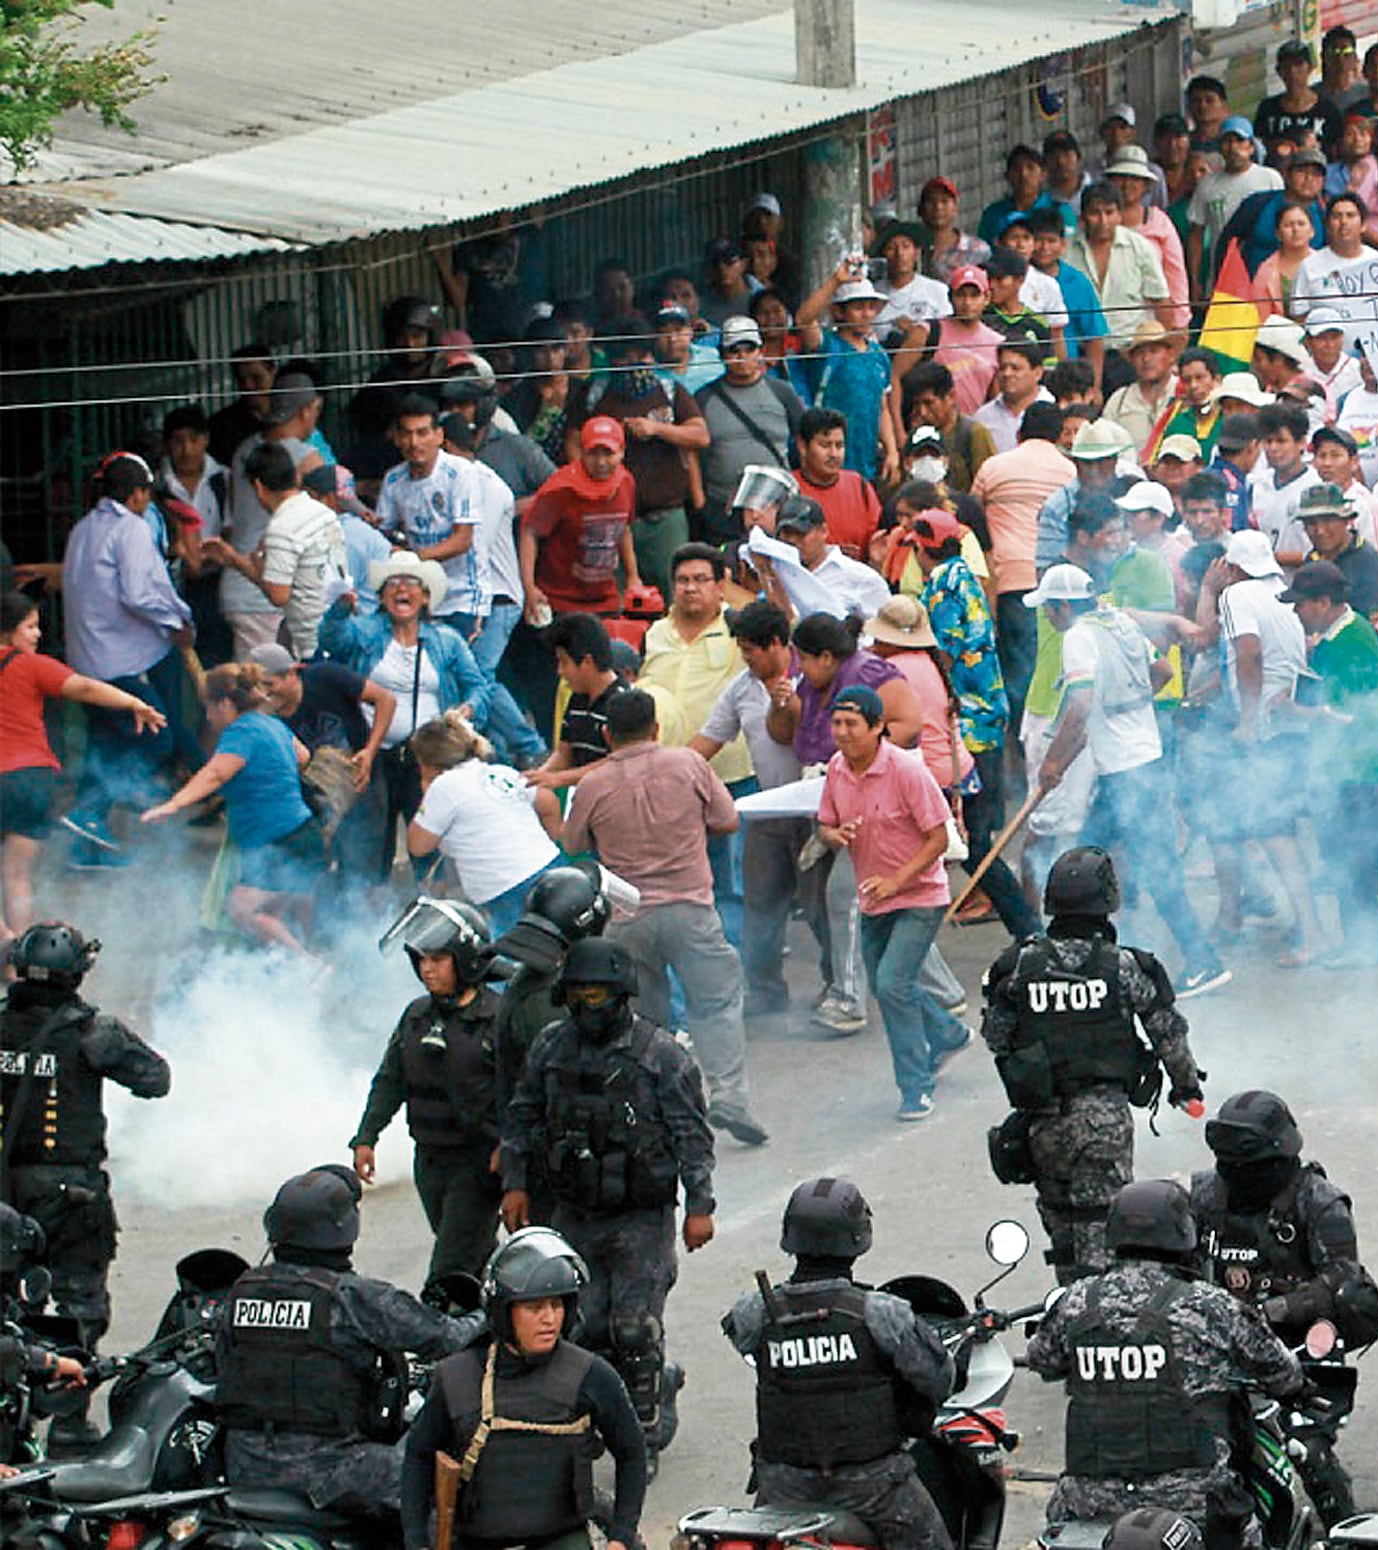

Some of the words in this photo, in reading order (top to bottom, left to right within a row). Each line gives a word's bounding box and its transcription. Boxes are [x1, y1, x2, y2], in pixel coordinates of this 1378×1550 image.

[1028, 979, 1108, 1013] UTOP
[1220, 1248, 1259, 1261] UTOP
[236, 1301, 305, 1327] POLICIA
[767, 1333, 858, 1369] POLICIA
[1076, 1344, 1166, 1380] UTOP
